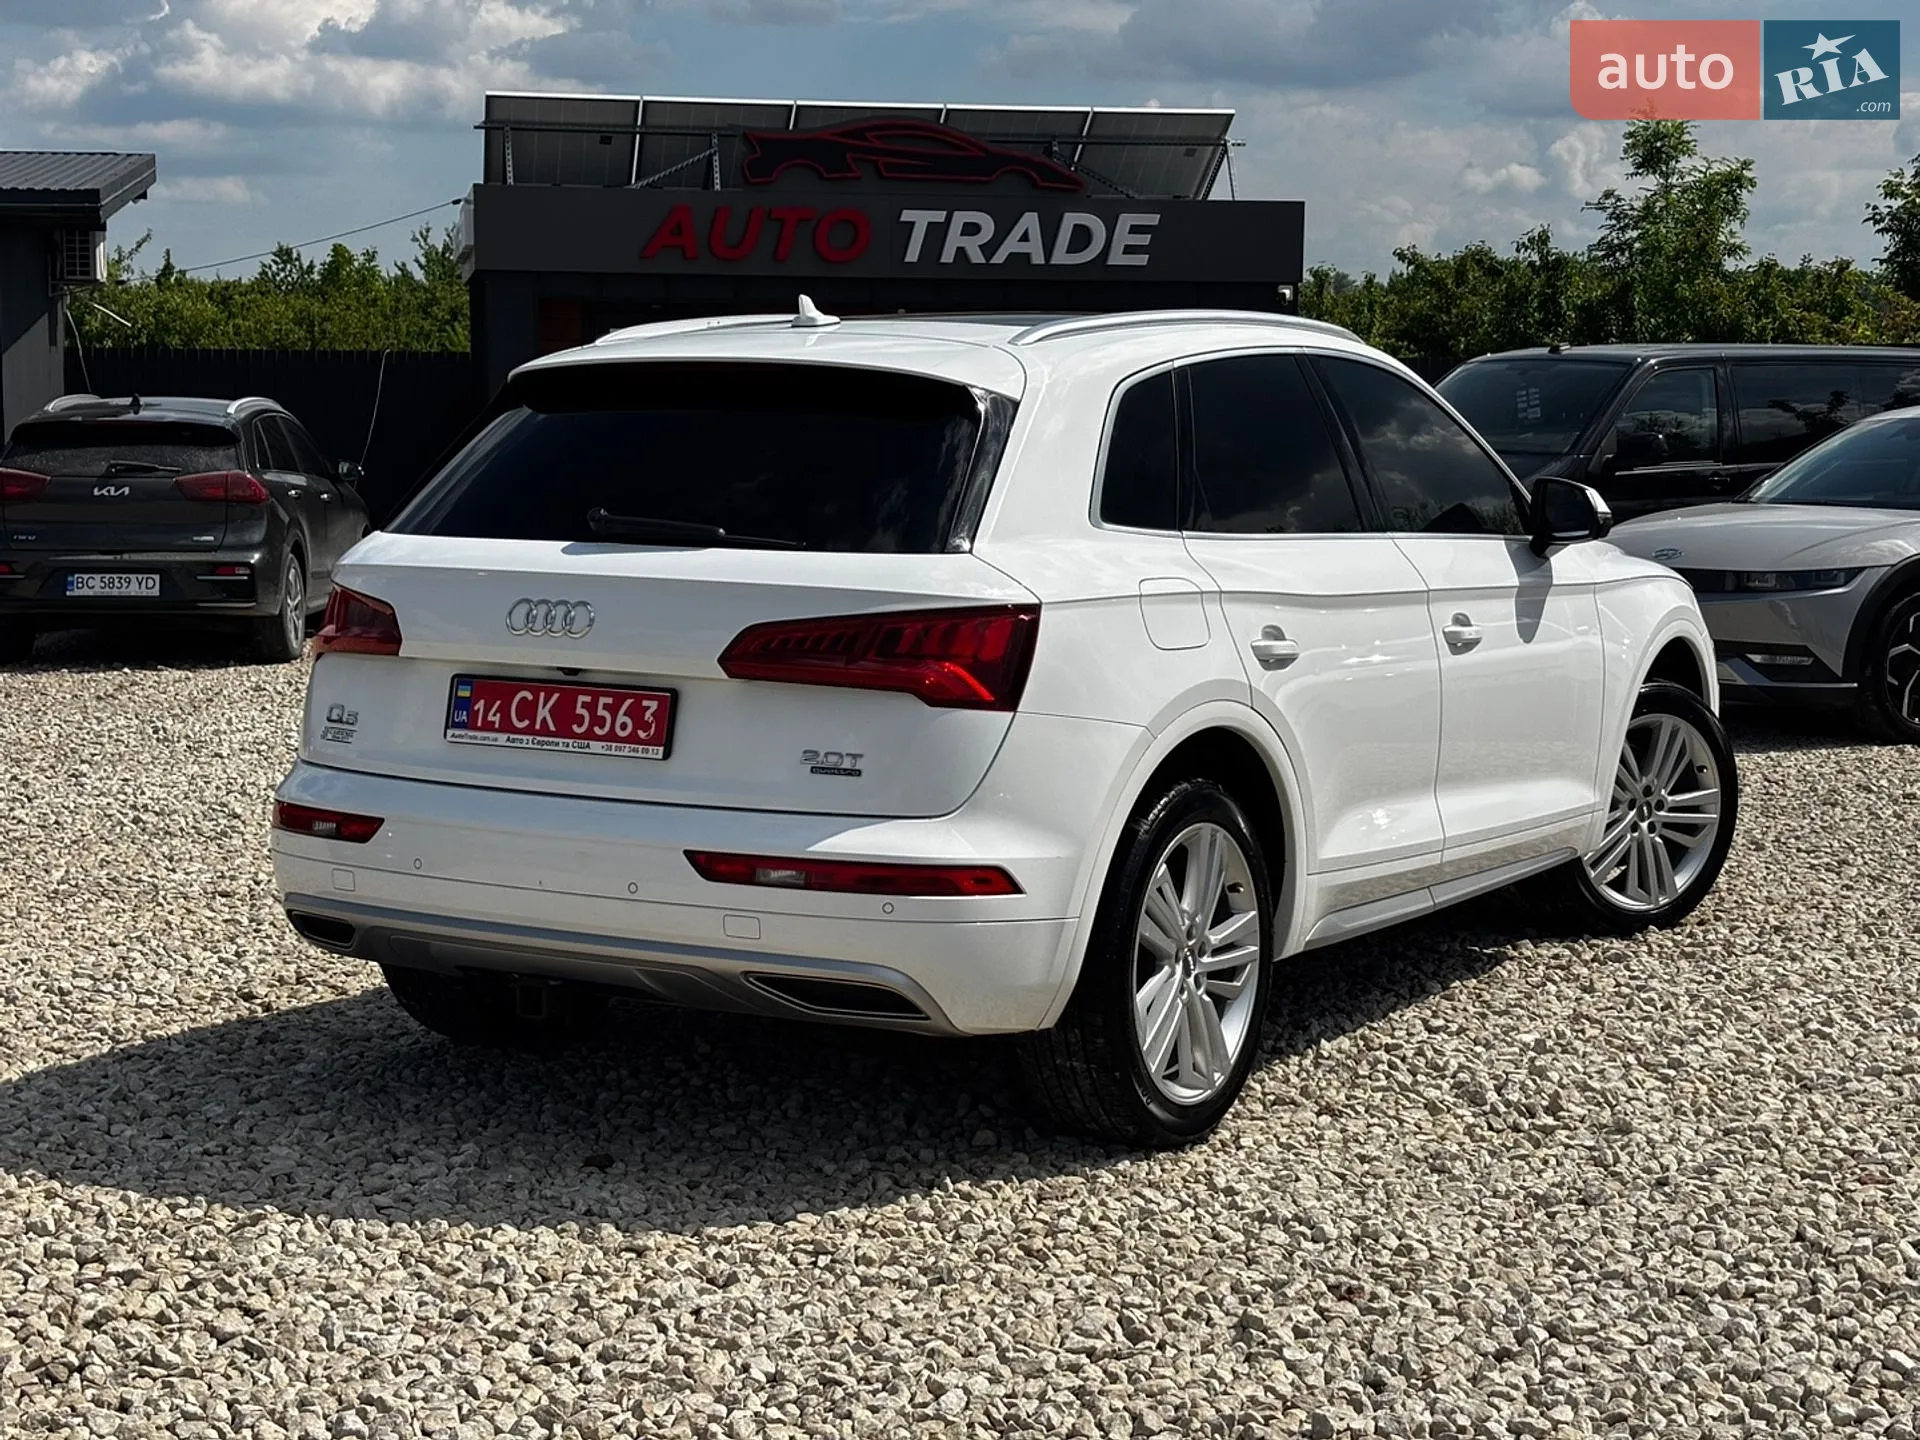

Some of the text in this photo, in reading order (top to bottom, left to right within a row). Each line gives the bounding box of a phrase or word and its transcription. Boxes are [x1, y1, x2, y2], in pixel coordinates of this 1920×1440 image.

[640, 204, 1162, 267] AUTO TRADE
[76, 576, 156, 591] BC 5839 YD
[453, 709, 468, 723] UA
[473, 690, 660, 740] 14 CK 5563
[571, 740, 591, 750] США
[800, 748, 864, 768] 2.0T
